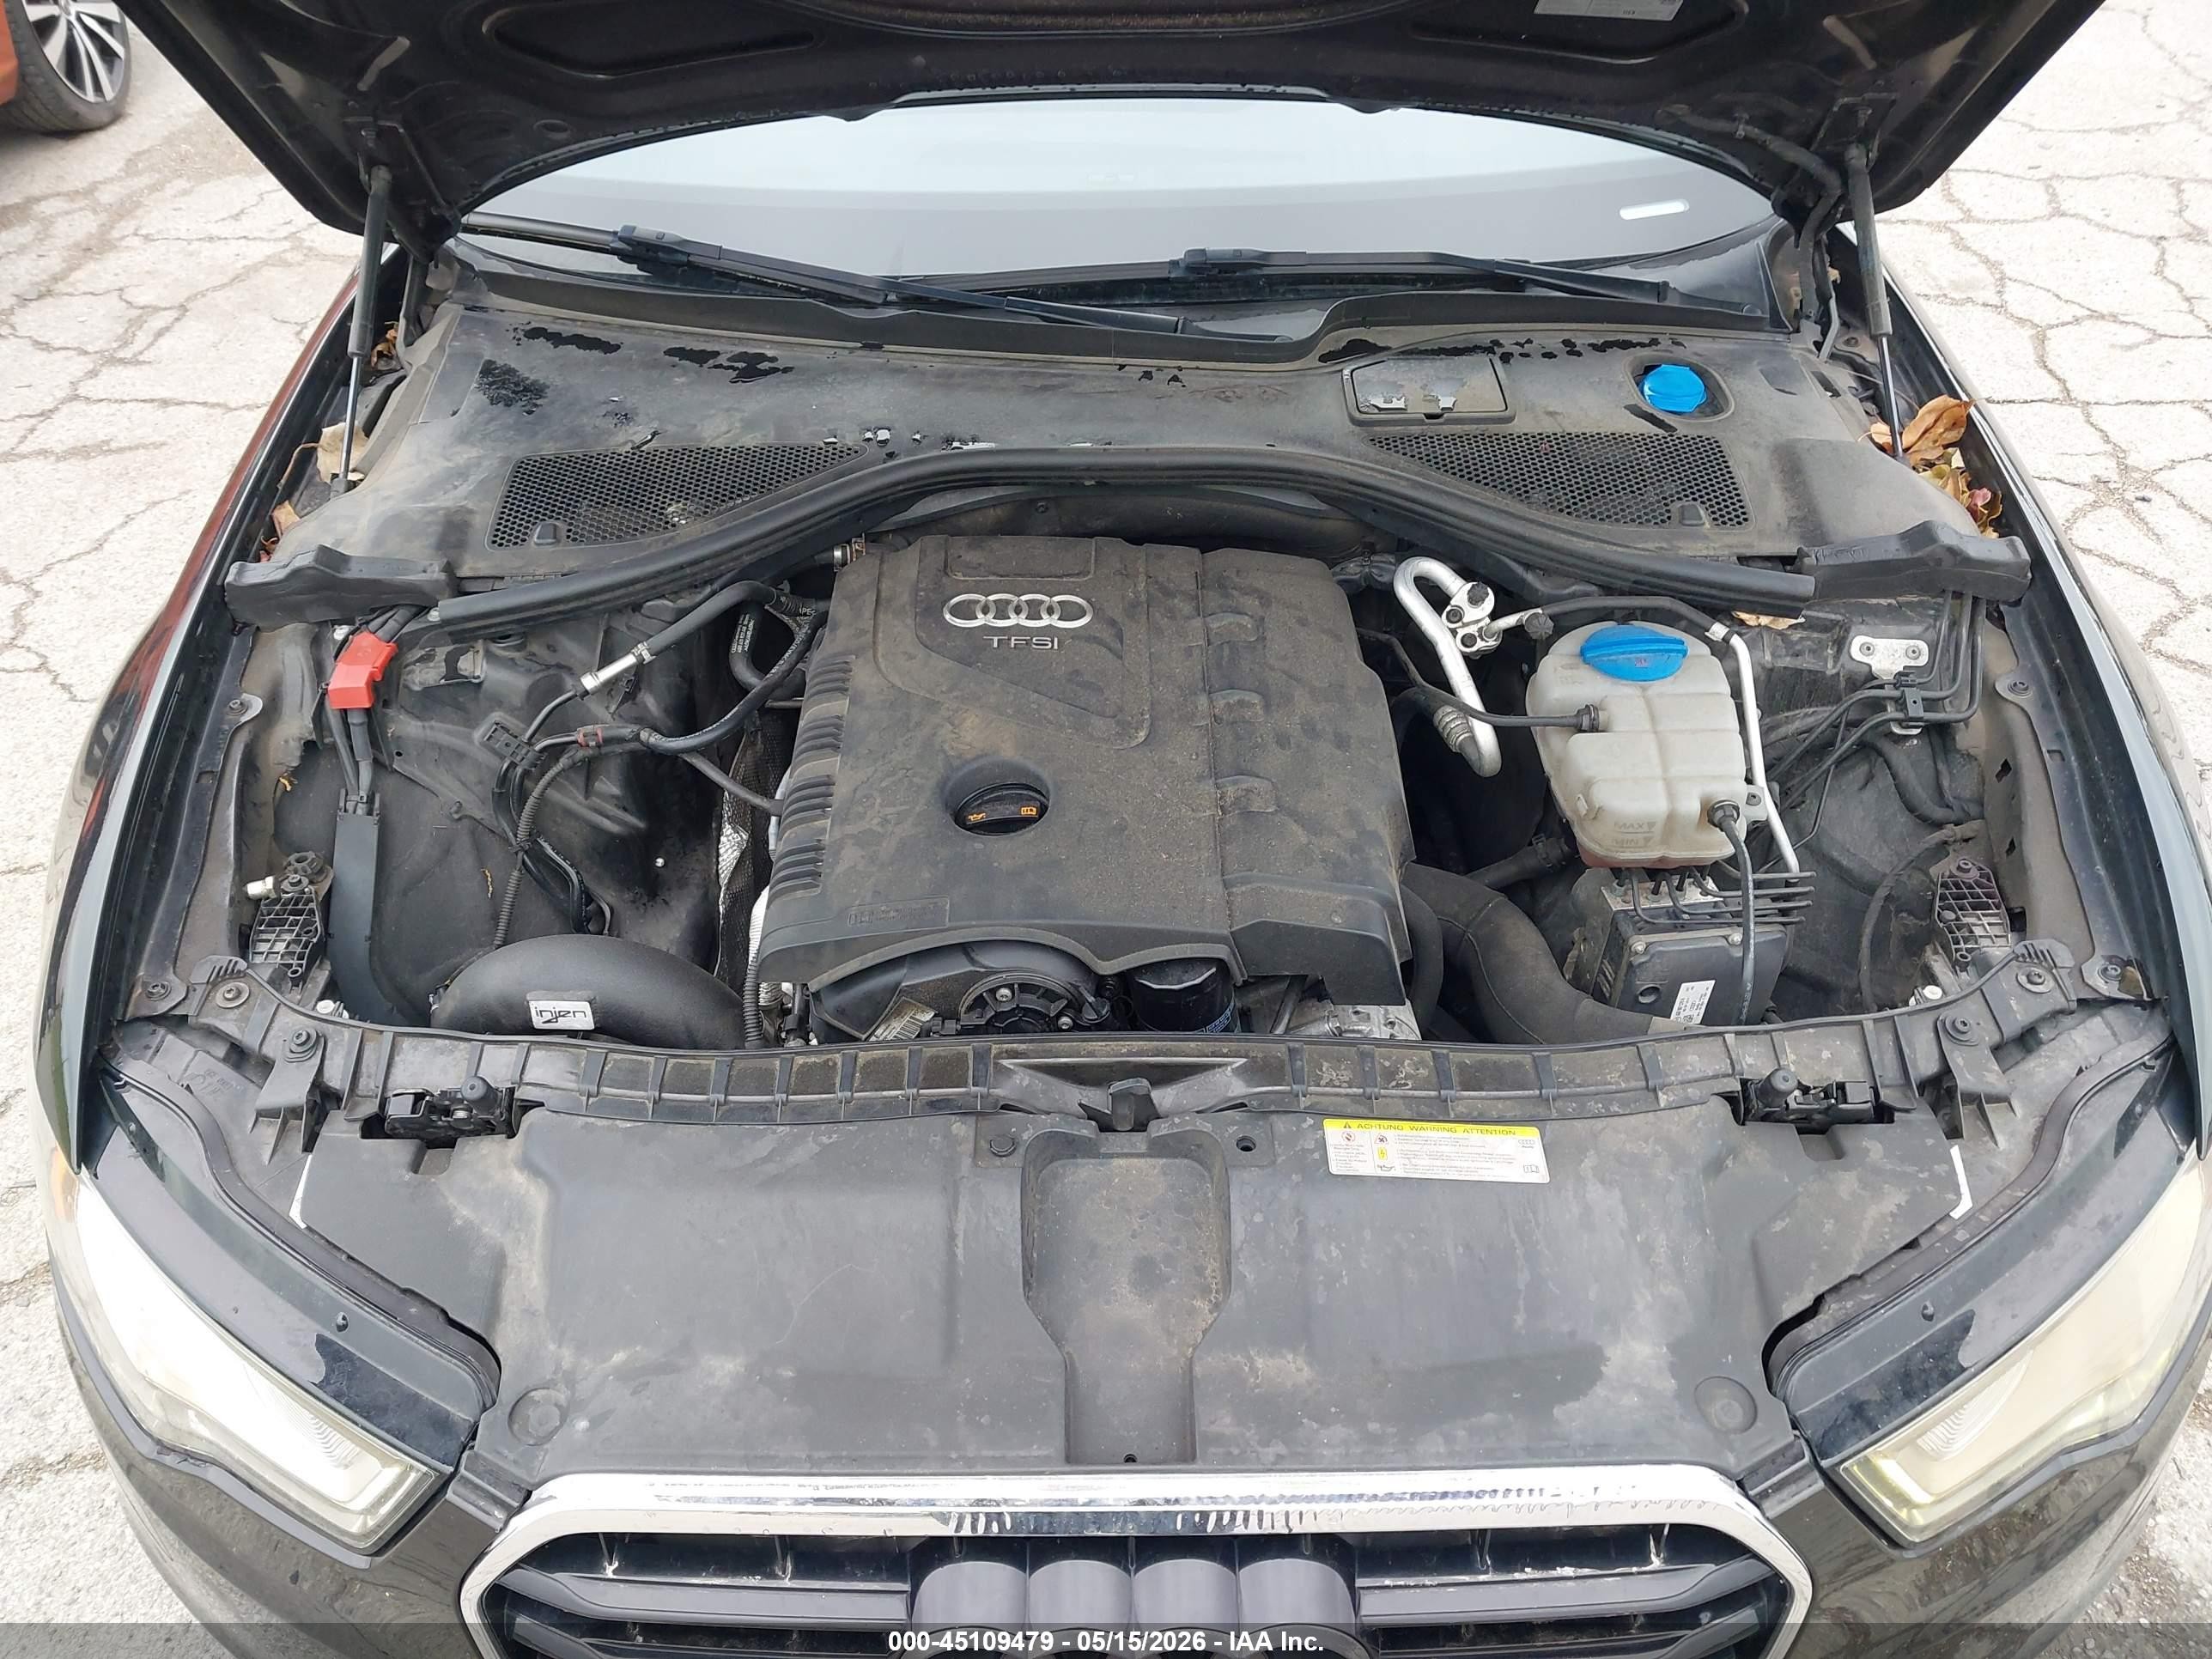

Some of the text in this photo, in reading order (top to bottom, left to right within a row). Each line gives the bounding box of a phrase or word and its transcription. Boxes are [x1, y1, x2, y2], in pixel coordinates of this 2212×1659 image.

[983, 635, 1059, 650] TFSI
[535, 1006, 587, 1024] injen
[1409, 1125, 1457, 1133] WARNING
[1462, 1127, 1516, 1136] ATTENTION
